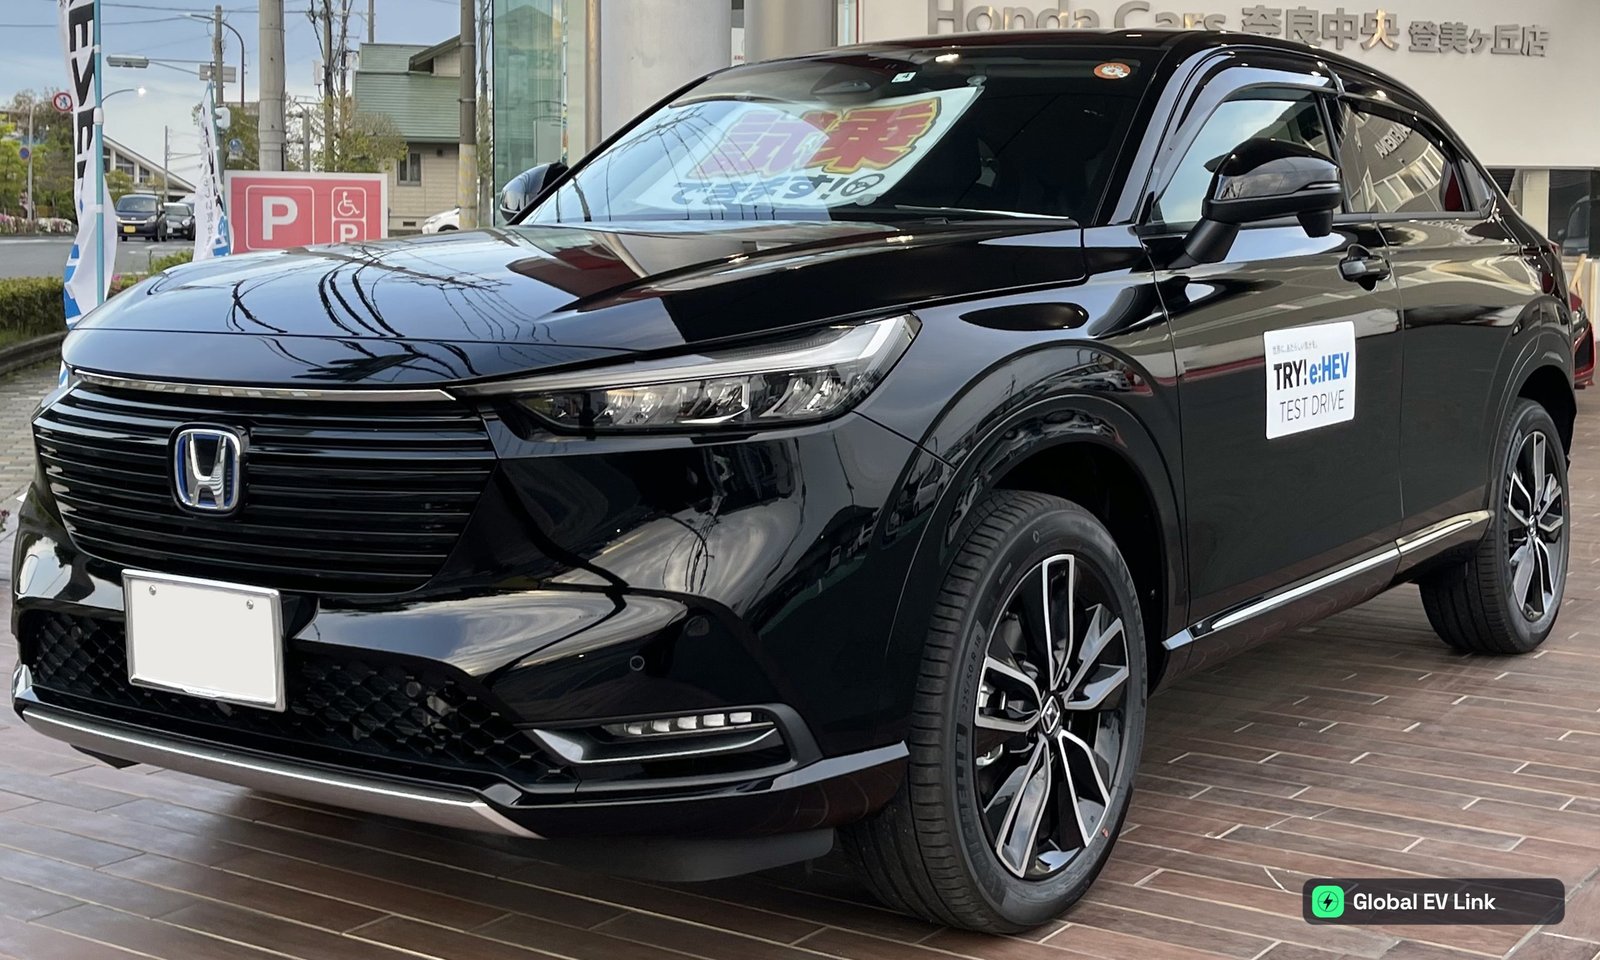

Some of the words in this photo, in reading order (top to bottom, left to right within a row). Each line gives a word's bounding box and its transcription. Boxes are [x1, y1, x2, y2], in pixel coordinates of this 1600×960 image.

[927, 0, 1100, 35] Honda
[1114, 0, 1226, 31] Cars
[1241, 4, 1400, 50] 奈良中央
[262, 195, 298, 241] P
[339, 223, 359, 242] P
[1273, 358, 1307, 391] TRY!
[1309, 351, 1350, 385] e:HEV
[1280, 397, 1308, 423] TEST
[1312, 389, 1345, 416] DRIVE
